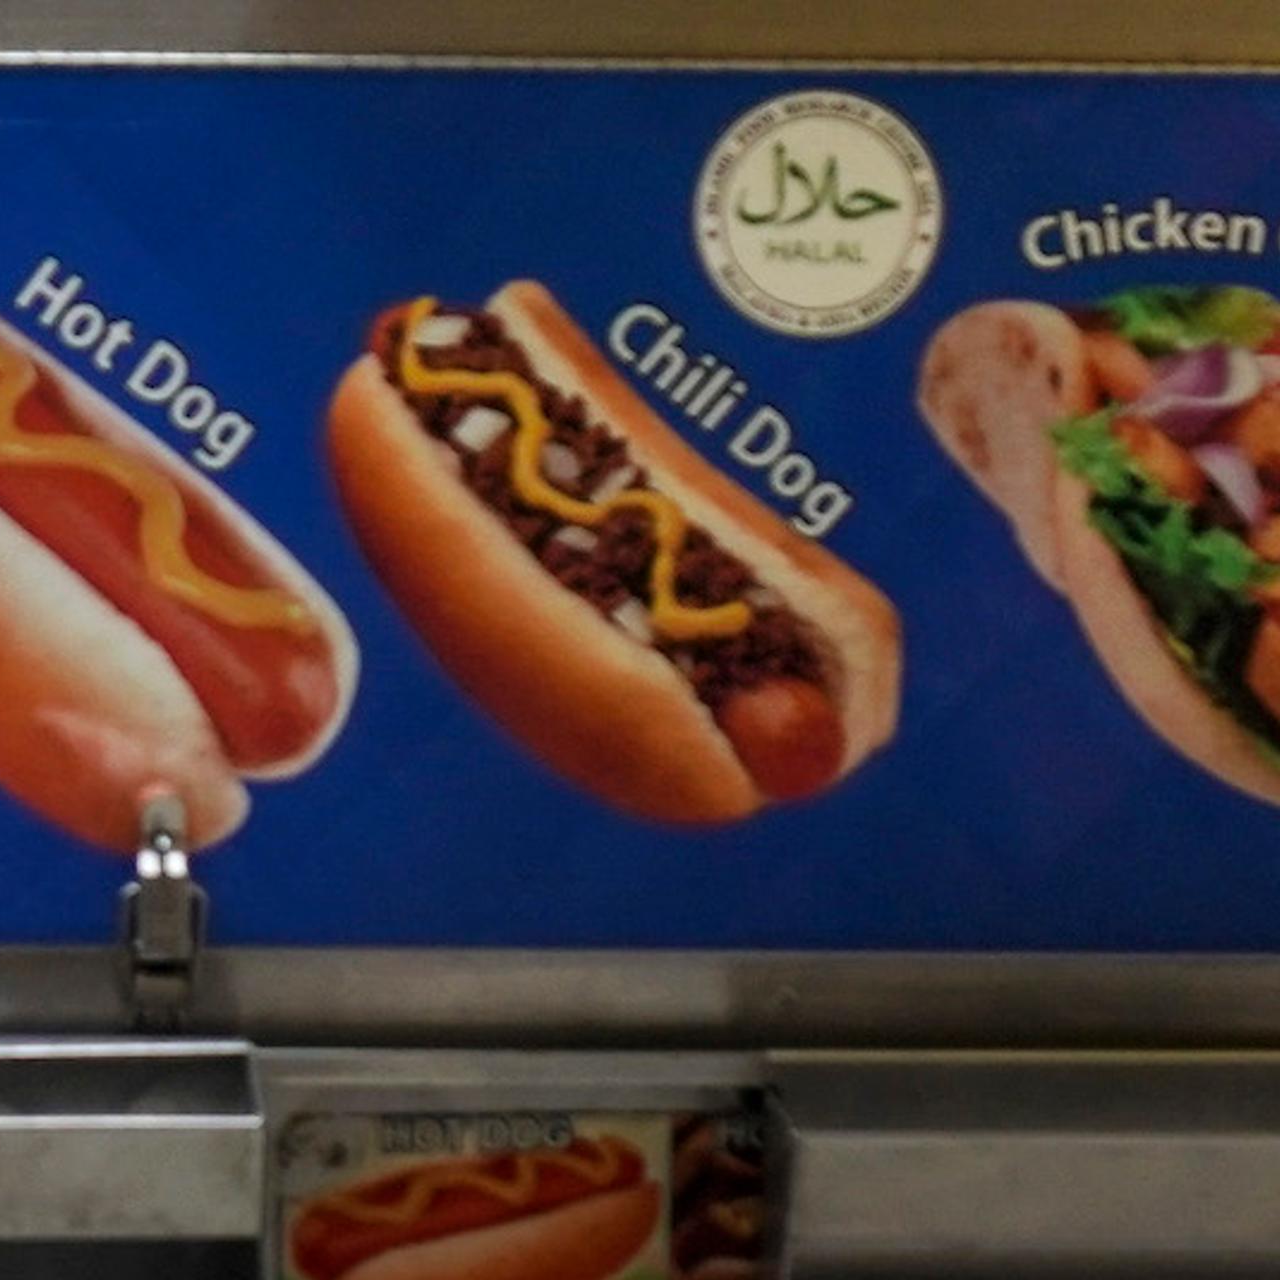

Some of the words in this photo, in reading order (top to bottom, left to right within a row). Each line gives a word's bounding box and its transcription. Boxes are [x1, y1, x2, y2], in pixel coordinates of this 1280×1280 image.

[736, 140, 900, 225] حلال
[765, 240, 868, 264] HALAL
[1020, 196, 1269, 269] Chicken
[14, 255, 134, 371] Hot
[125, 338, 256, 469] Dog
[608, 303, 749, 431] Chili
[728, 404, 854, 538] Dog
